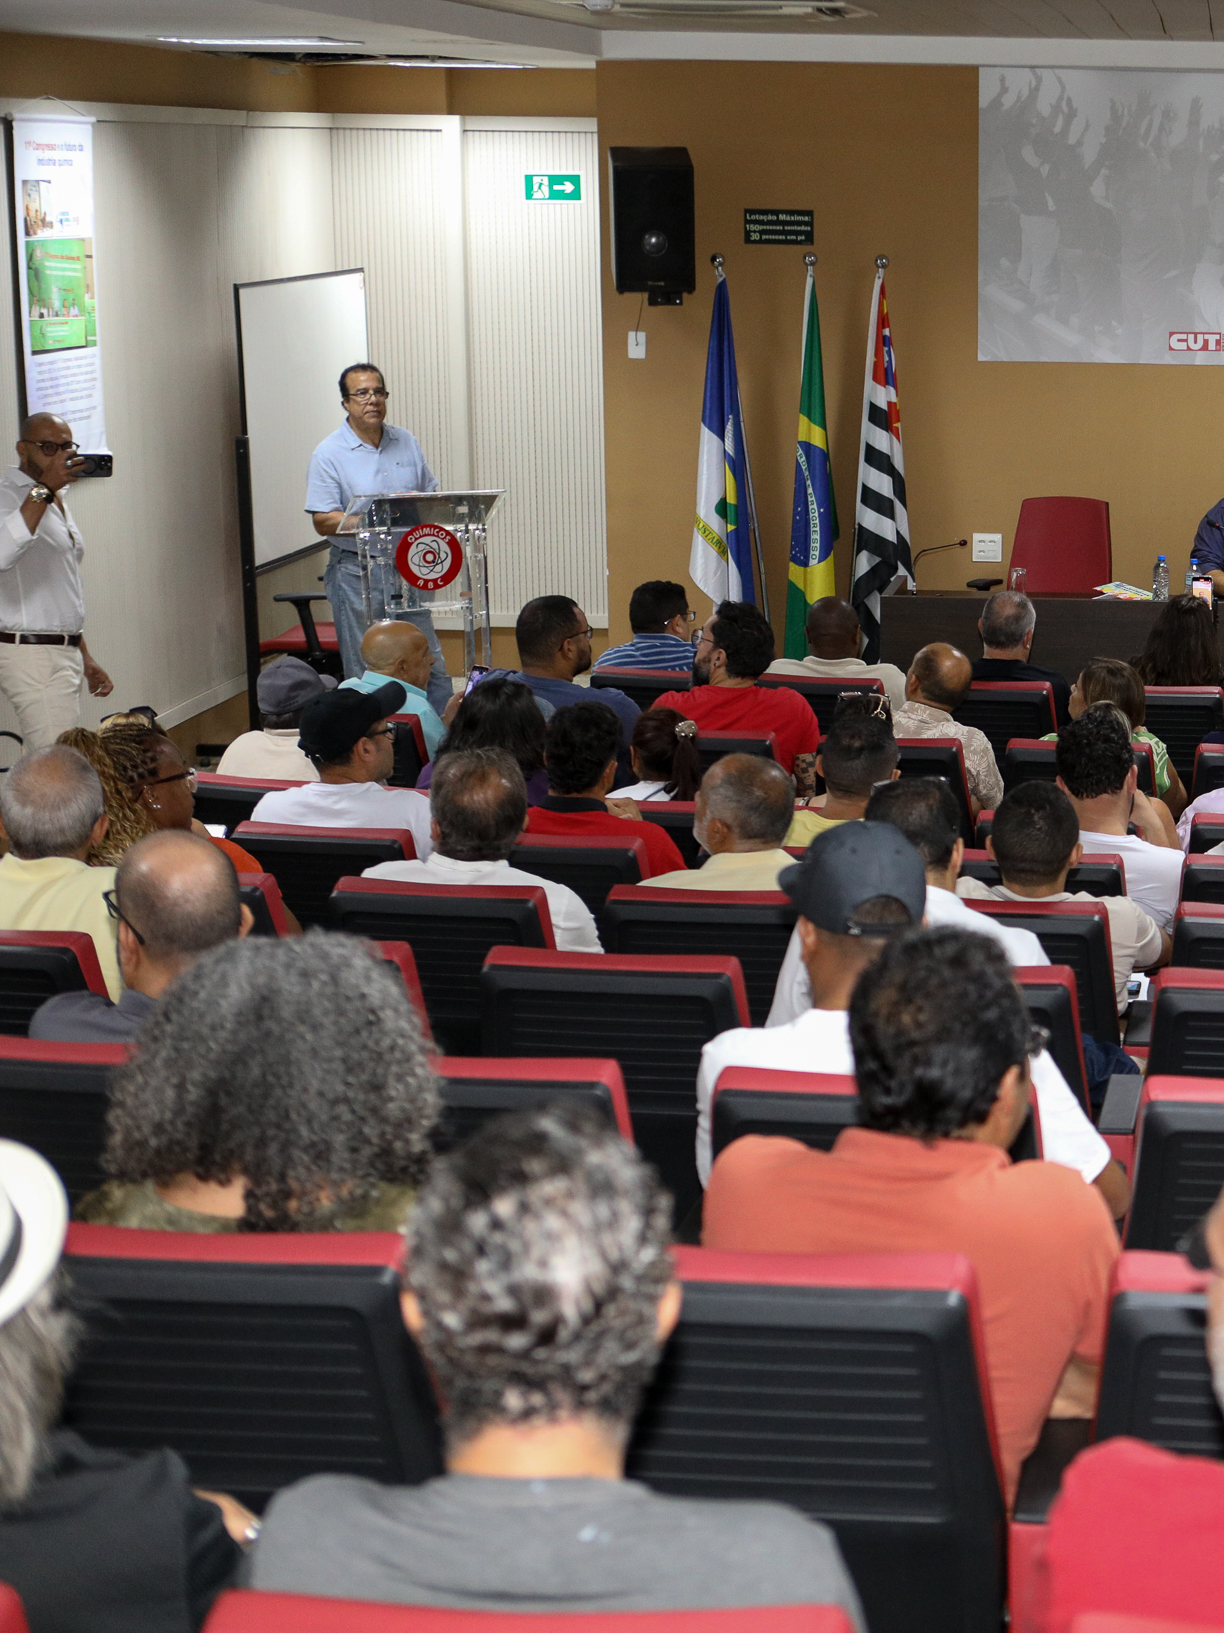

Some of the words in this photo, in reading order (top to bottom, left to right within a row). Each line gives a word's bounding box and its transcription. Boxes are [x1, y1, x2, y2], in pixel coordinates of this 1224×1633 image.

[1169, 333, 1221, 350] CUT
[407, 526, 451, 543] QUÍMICOS
[808, 492, 818, 561] PROGRESSO
